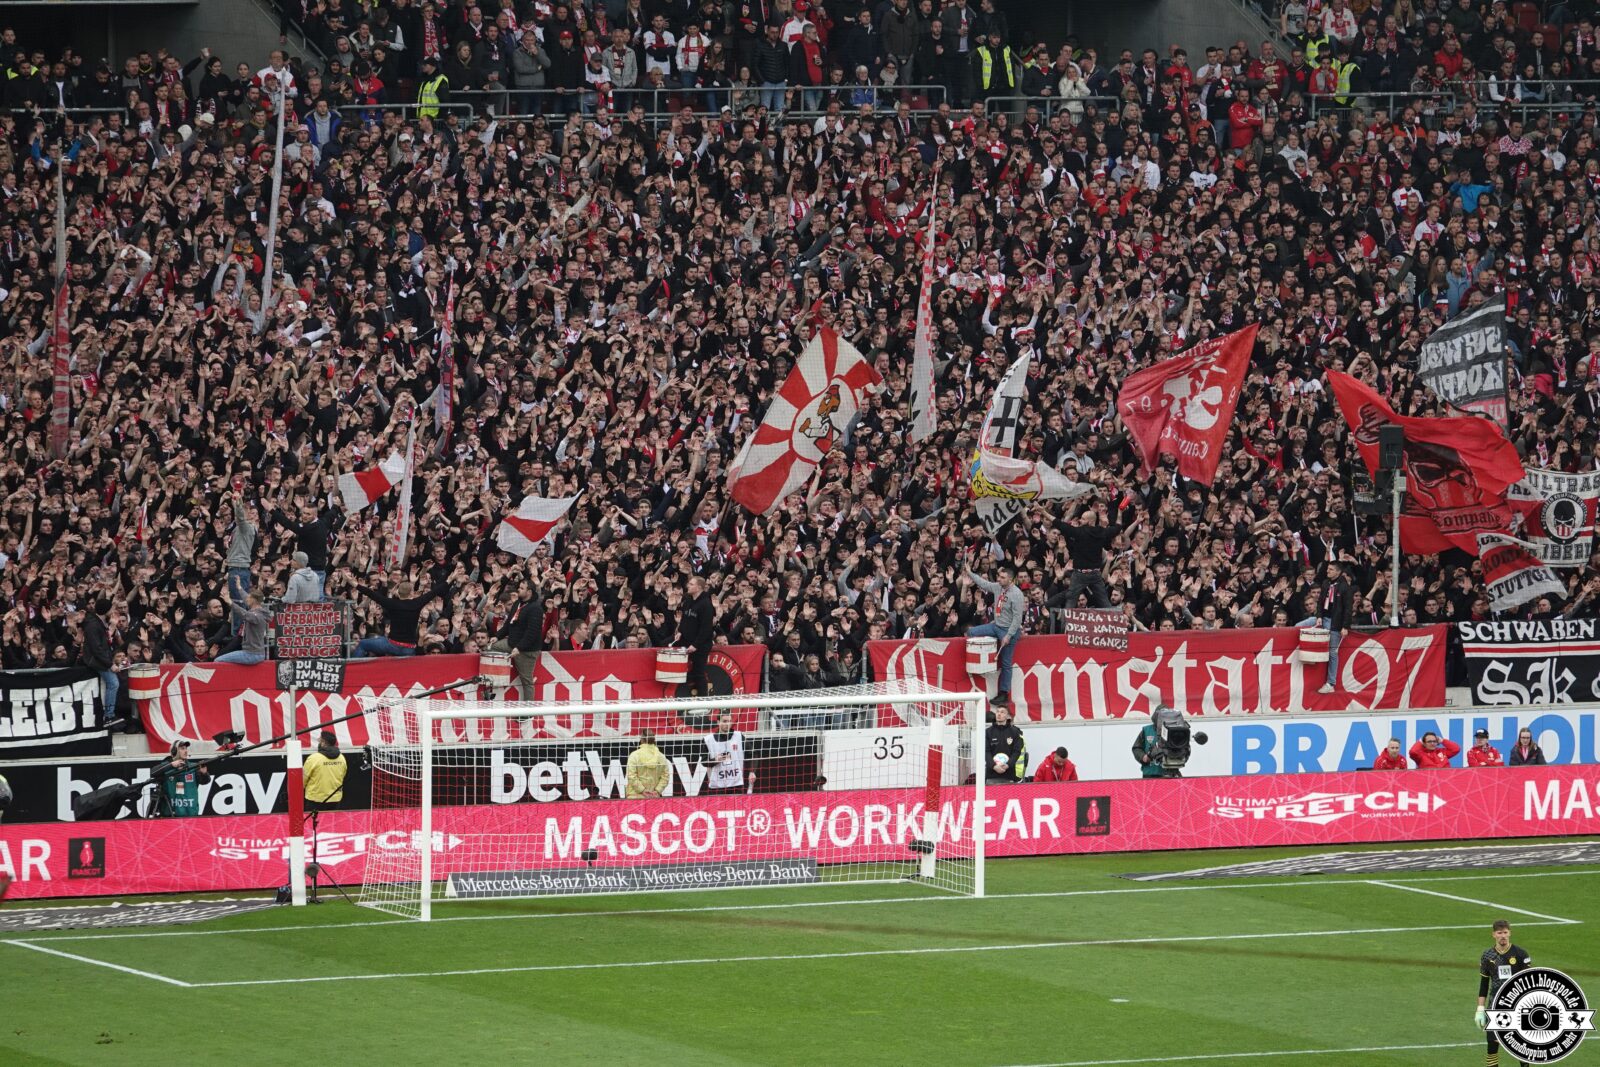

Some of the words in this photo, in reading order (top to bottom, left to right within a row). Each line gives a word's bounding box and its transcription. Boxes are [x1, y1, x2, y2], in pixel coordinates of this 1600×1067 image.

[283, 602, 335, 612] JEDER
[276, 610, 342, 626] VERBANNTE
[1064, 608, 1103, 622] ULTRA
[282, 624, 336, 635] KEHRT
[1065, 622, 1088, 633] DER
[1458, 618, 1597, 642] SCHWABEN
[1067, 633, 1090, 646] UMS
[1092, 636, 1128, 650] GANZE
[296, 660, 312, 670] DU
[316, 660, 342, 673] BIST
[295, 669, 340, 684] IMMER
[885, 637, 1312, 727] Cnnstatt
[1342, 633, 1435, 713] 97
[873, 735, 904, 761] 35
[718, 768, 740, 779] SMF
[57, 767, 286, 822] btay
[171, 799, 194, 808] HOST
[1216, 790, 1428, 820] STRETCH
[1361, 811, 1415, 819] WORKWEAR
[783, 797, 1061, 849] WORKWEAR
[217, 835, 290, 848] ULTIMA
[457, 874, 582, 893] Mercedes-Benz
[587, 872, 629, 888] Bank
[642, 865, 766, 886] Mercedes-Benz
[769, 862, 814, 880] Bank
